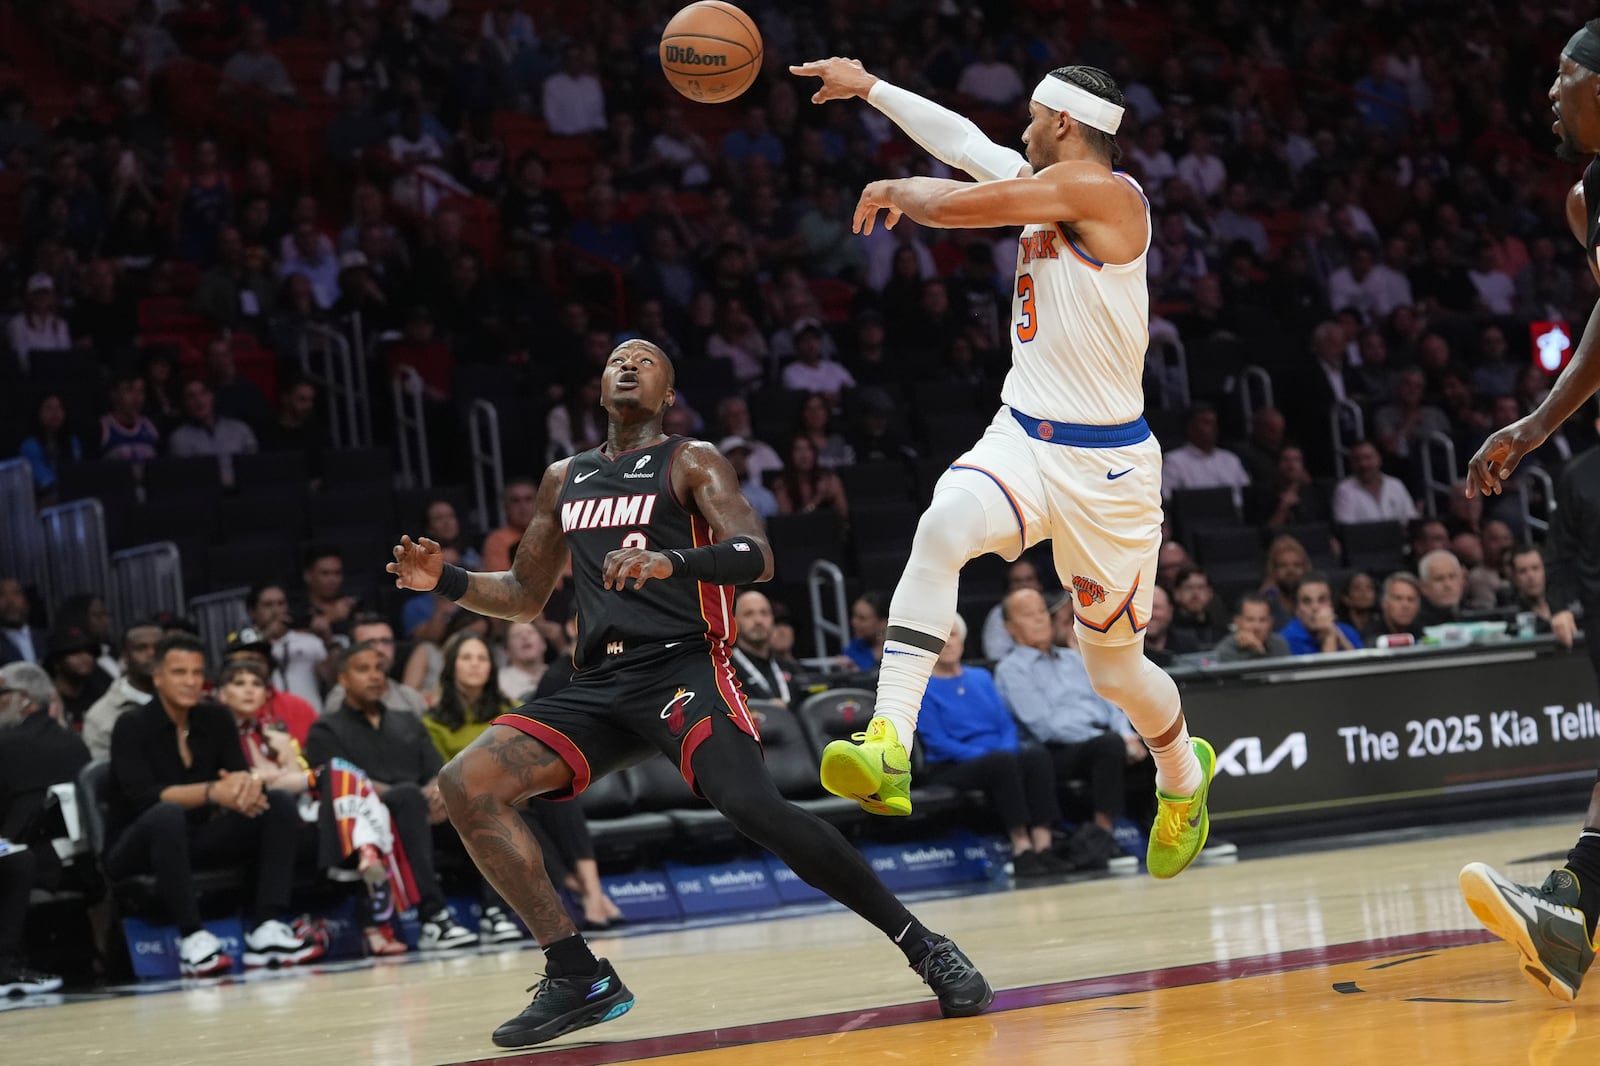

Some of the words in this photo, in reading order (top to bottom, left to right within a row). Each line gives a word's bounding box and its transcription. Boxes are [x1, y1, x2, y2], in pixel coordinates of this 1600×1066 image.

[666, 45, 727, 66] Wilson
[1017, 273, 1038, 343] 3
[560, 493, 658, 533] MIAMI
[1337, 725, 1400, 764] The
[1405, 713, 1483, 758] 2025
[1489, 710, 1538, 748] Kia
